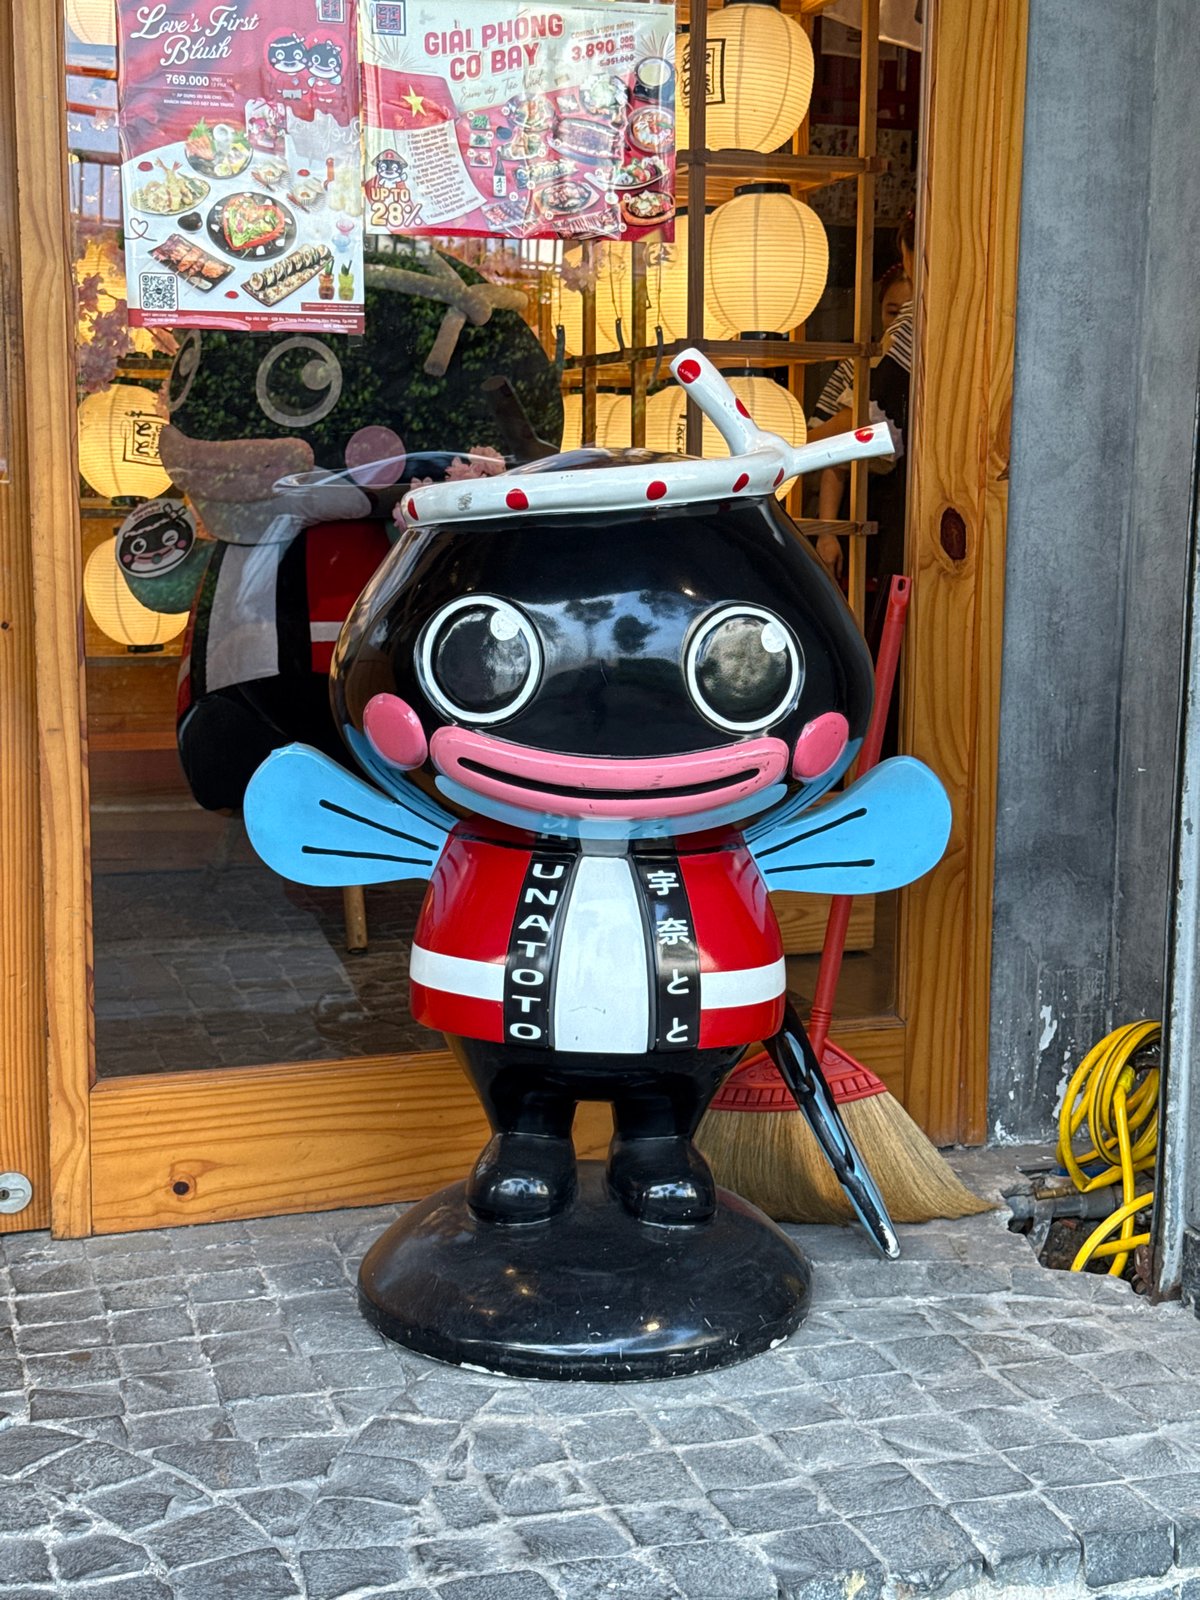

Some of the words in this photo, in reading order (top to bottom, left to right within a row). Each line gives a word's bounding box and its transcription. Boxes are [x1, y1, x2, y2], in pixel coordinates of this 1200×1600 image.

[130, 4, 202, 39] Love's
[205, 5, 259, 36] First
[482, 9, 563, 48] PHÓNG
[160, 35, 232, 66] Blush
[491, 42, 539, 73] BAY
[571, 39, 615, 62] 3.890
[165, 74, 210, 86] 769.000
[371, 187, 390, 202] UP
[390, 187, 410, 203] TO
[371, 202, 423, 227] 28%
[509, 863, 564, 1040] UNATOTO
[647, 870, 690, 1043] 宇奈とと
